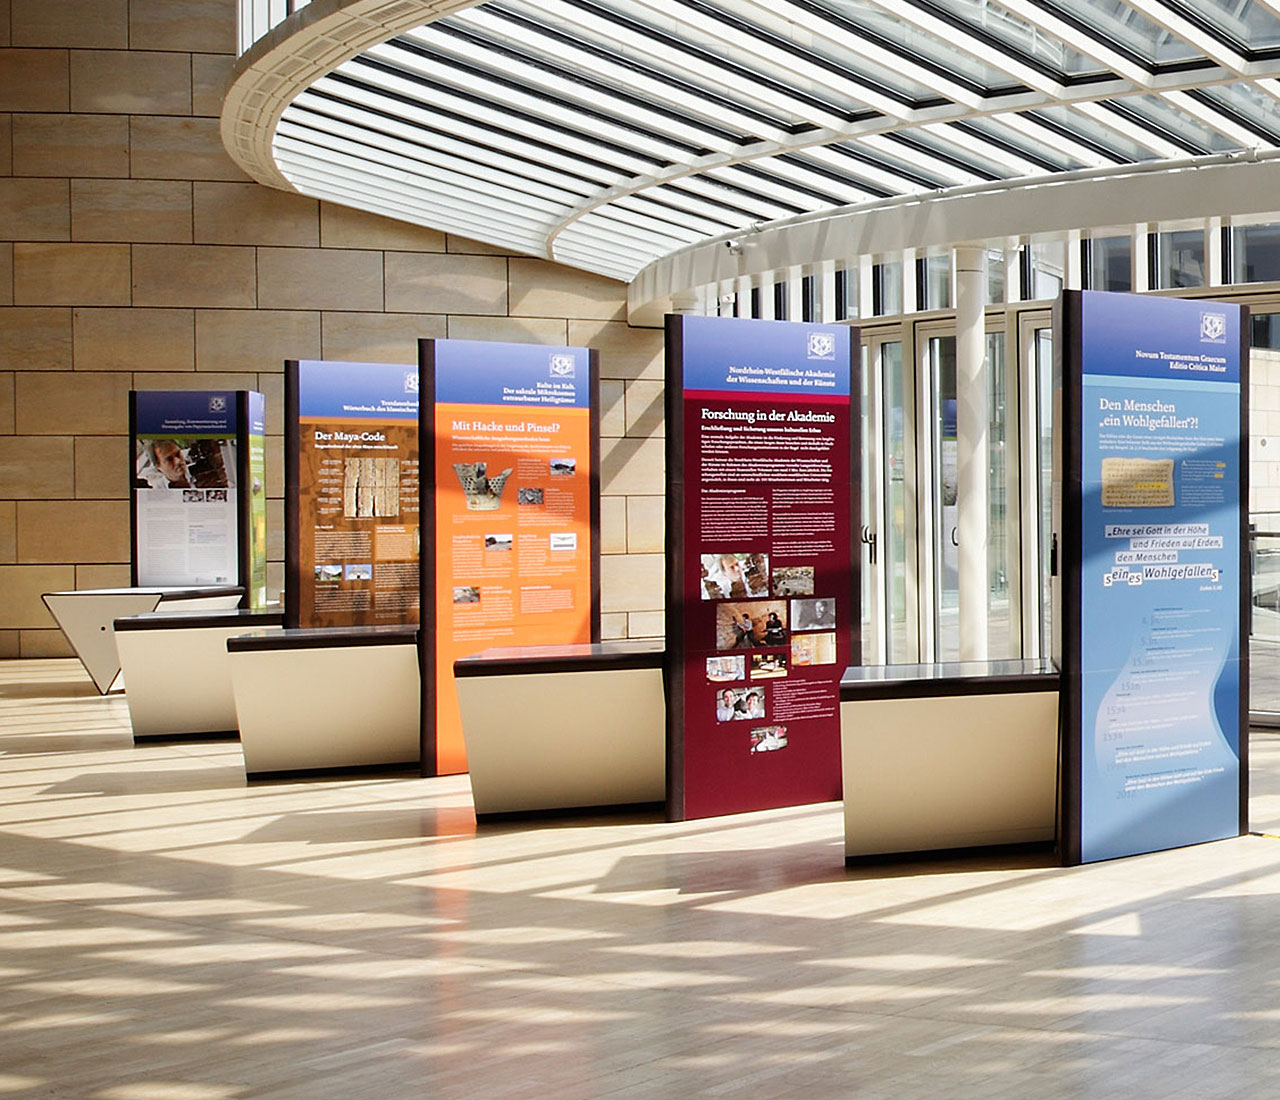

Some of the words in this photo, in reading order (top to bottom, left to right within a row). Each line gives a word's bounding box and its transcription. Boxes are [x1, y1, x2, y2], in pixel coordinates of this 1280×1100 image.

[1136, 350, 1159, 359] Novum
[1160, 352, 1200, 362] Testamentum
[1201, 355, 1226, 364] Graecum
[1170, 362, 1187, 370] Editio
[1189, 363, 1208, 371] Critica
[1209, 364, 1227, 372] Maior
[739, 376, 788, 385] Wissenschaften
[789, 378, 802, 386] und
[803, 378, 813, 386] der
[1100, 398, 1121, 411] Den
[1124, 399, 1176, 413] Menschen
[701, 408, 755, 423] Forschung
[757, 410, 767, 421] in
[769, 410, 786, 422] der
[787, 410, 836, 423] Akademie
[1099, 414, 1121, 427] „ein
[452, 421, 470, 431] Mit
[473, 421, 503, 432] Hacke
[505, 422, 525, 432] und
[527, 423, 560, 433] Pinsel?
[315, 432, 332, 440] Der
[334, 432, 386, 443] Maya-Code
[1133, 527, 1145, 536] sei
[1146, 527, 1163, 535] Gott
[1164, 526, 1172, 535] in
[1173, 526, 1186, 535] der
[1187, 526, 1207, 535] Höhe
[1133, 540, 1149, 548] und
[1151, 539, 1181, 548] Frieden
[1182, 539, 1196, 549] auf
[1117, 553, 1133, 562] den
[1135, 552, 1177, 562] Menschen
